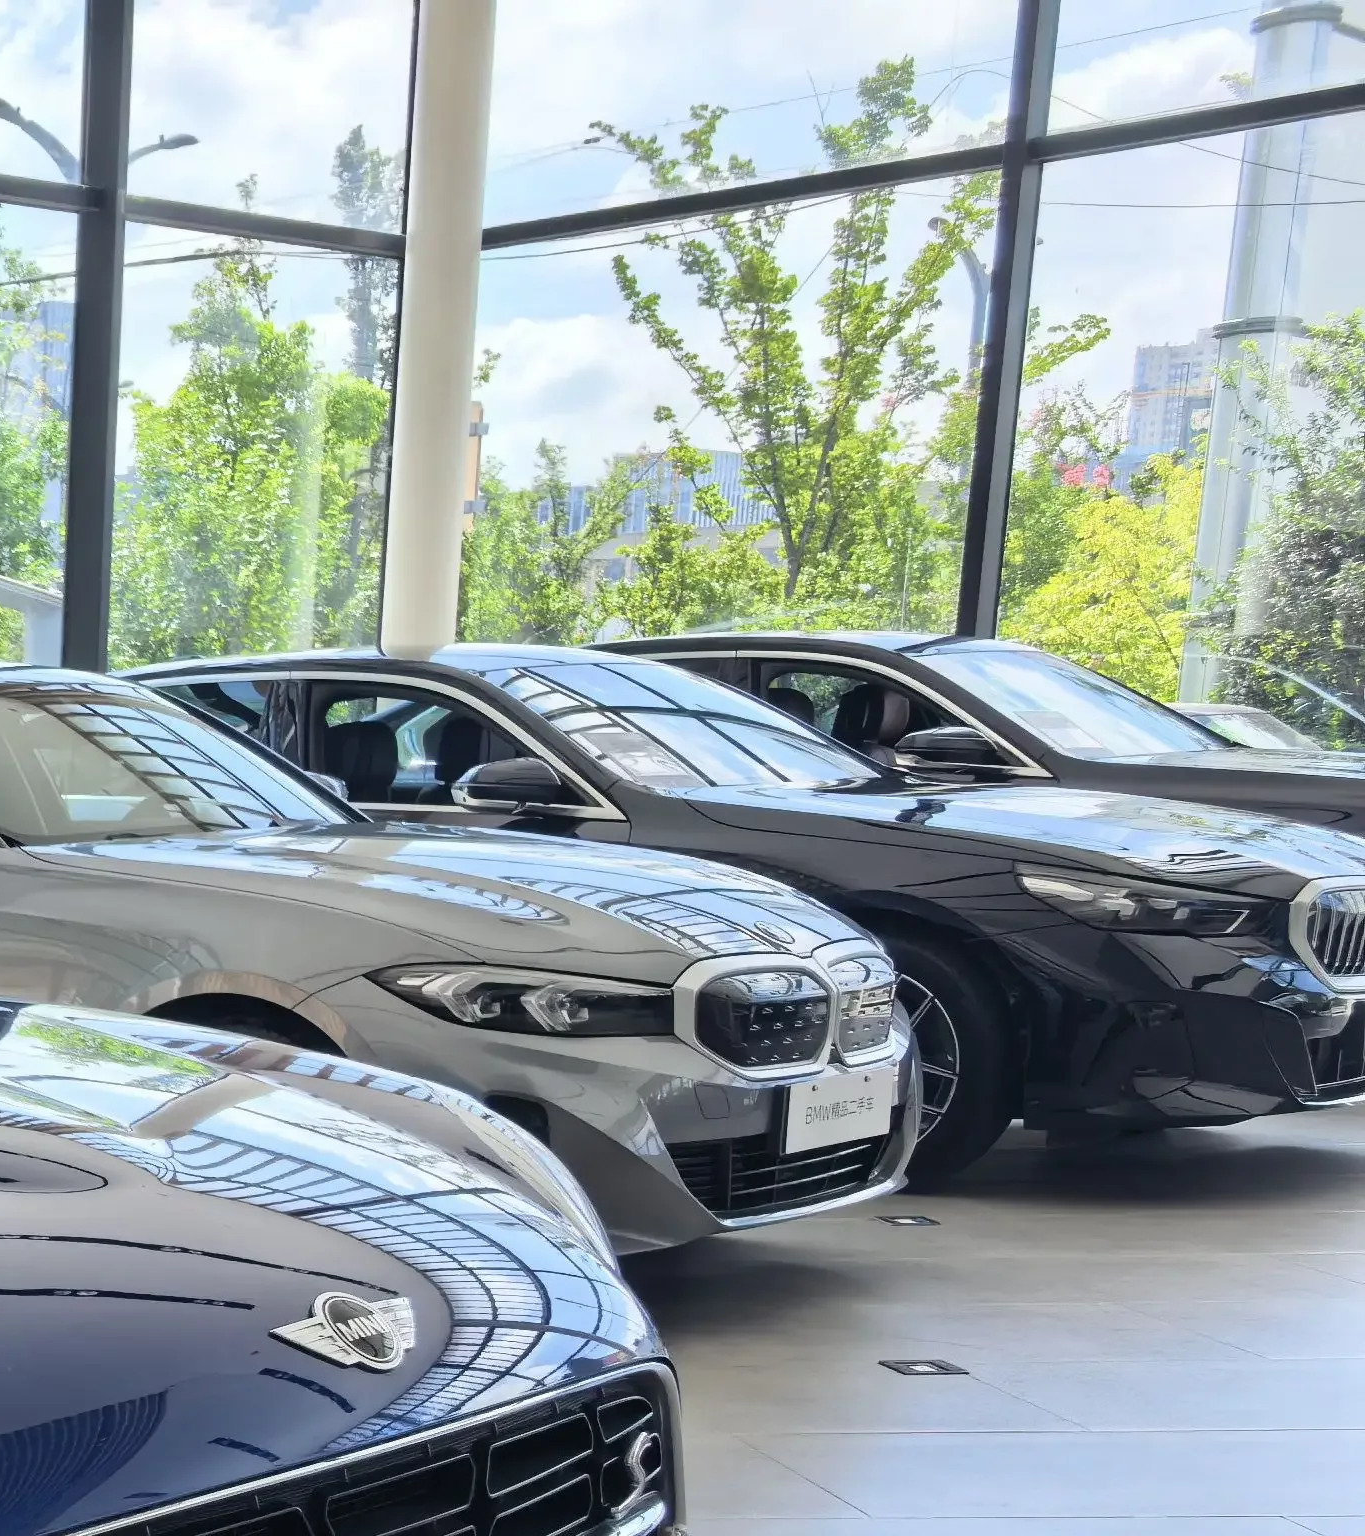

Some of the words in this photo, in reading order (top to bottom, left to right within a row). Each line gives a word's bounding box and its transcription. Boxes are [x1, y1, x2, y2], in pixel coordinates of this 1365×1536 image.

[804, 1096, 875, 1125] BMW精品二手车
[335, 1314, 387, 1342] MINI
